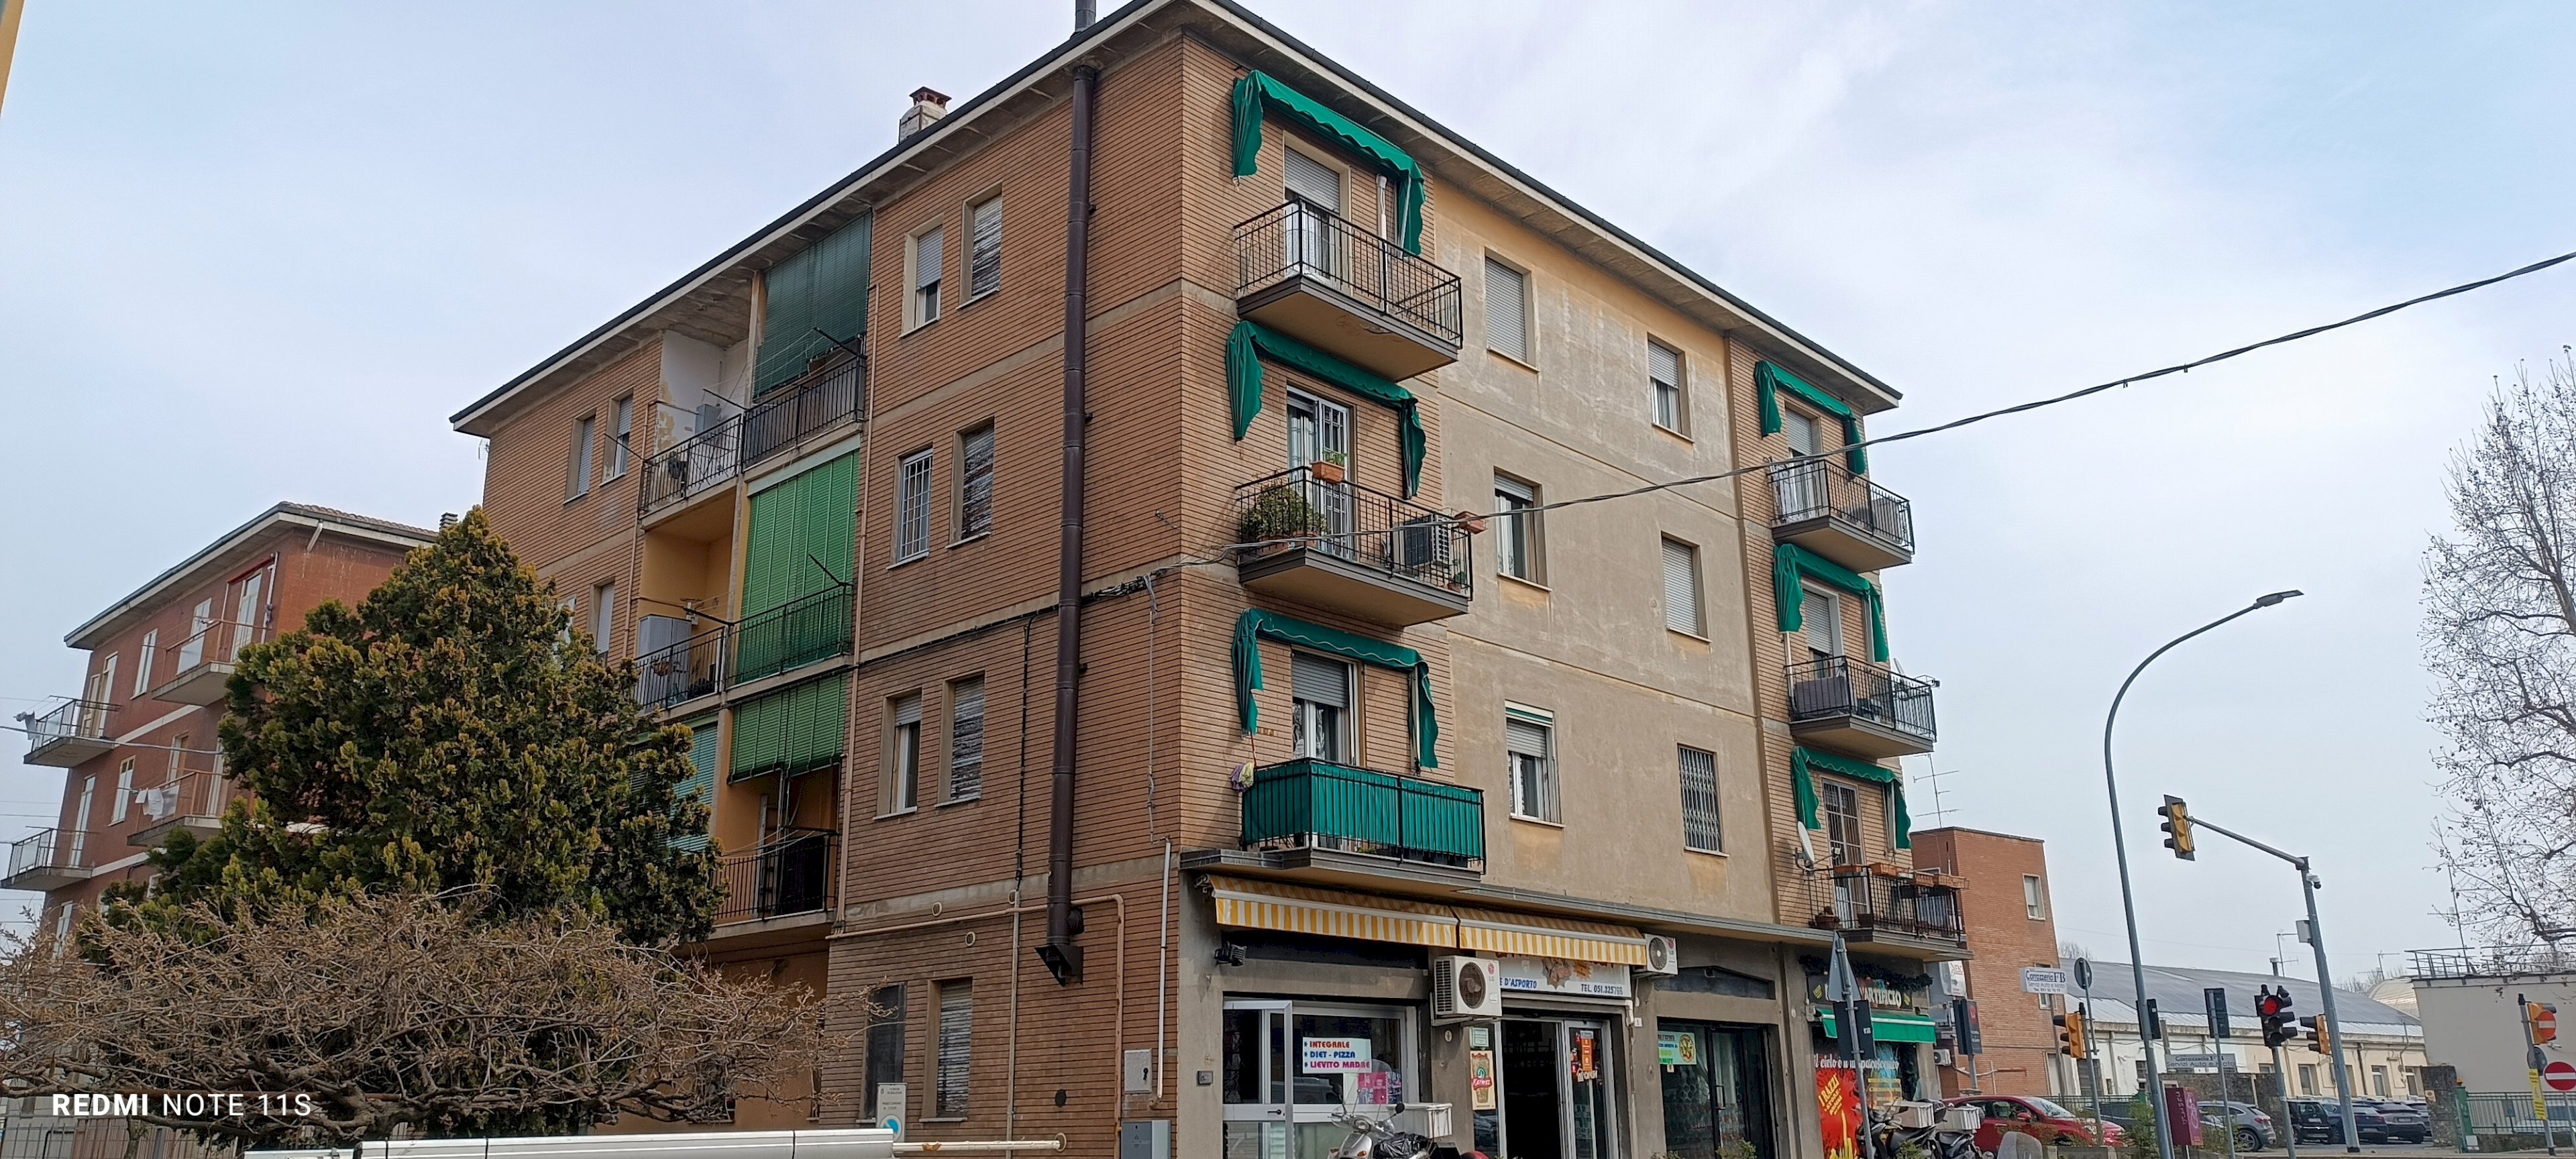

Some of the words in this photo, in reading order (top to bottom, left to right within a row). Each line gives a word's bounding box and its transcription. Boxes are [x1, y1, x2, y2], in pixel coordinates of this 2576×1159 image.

[1505, 977, 1537, 989] D'ASPORTO
[2054, 972, 2066, 983] FB
[1581, 983, 1592, 993] TEL.
